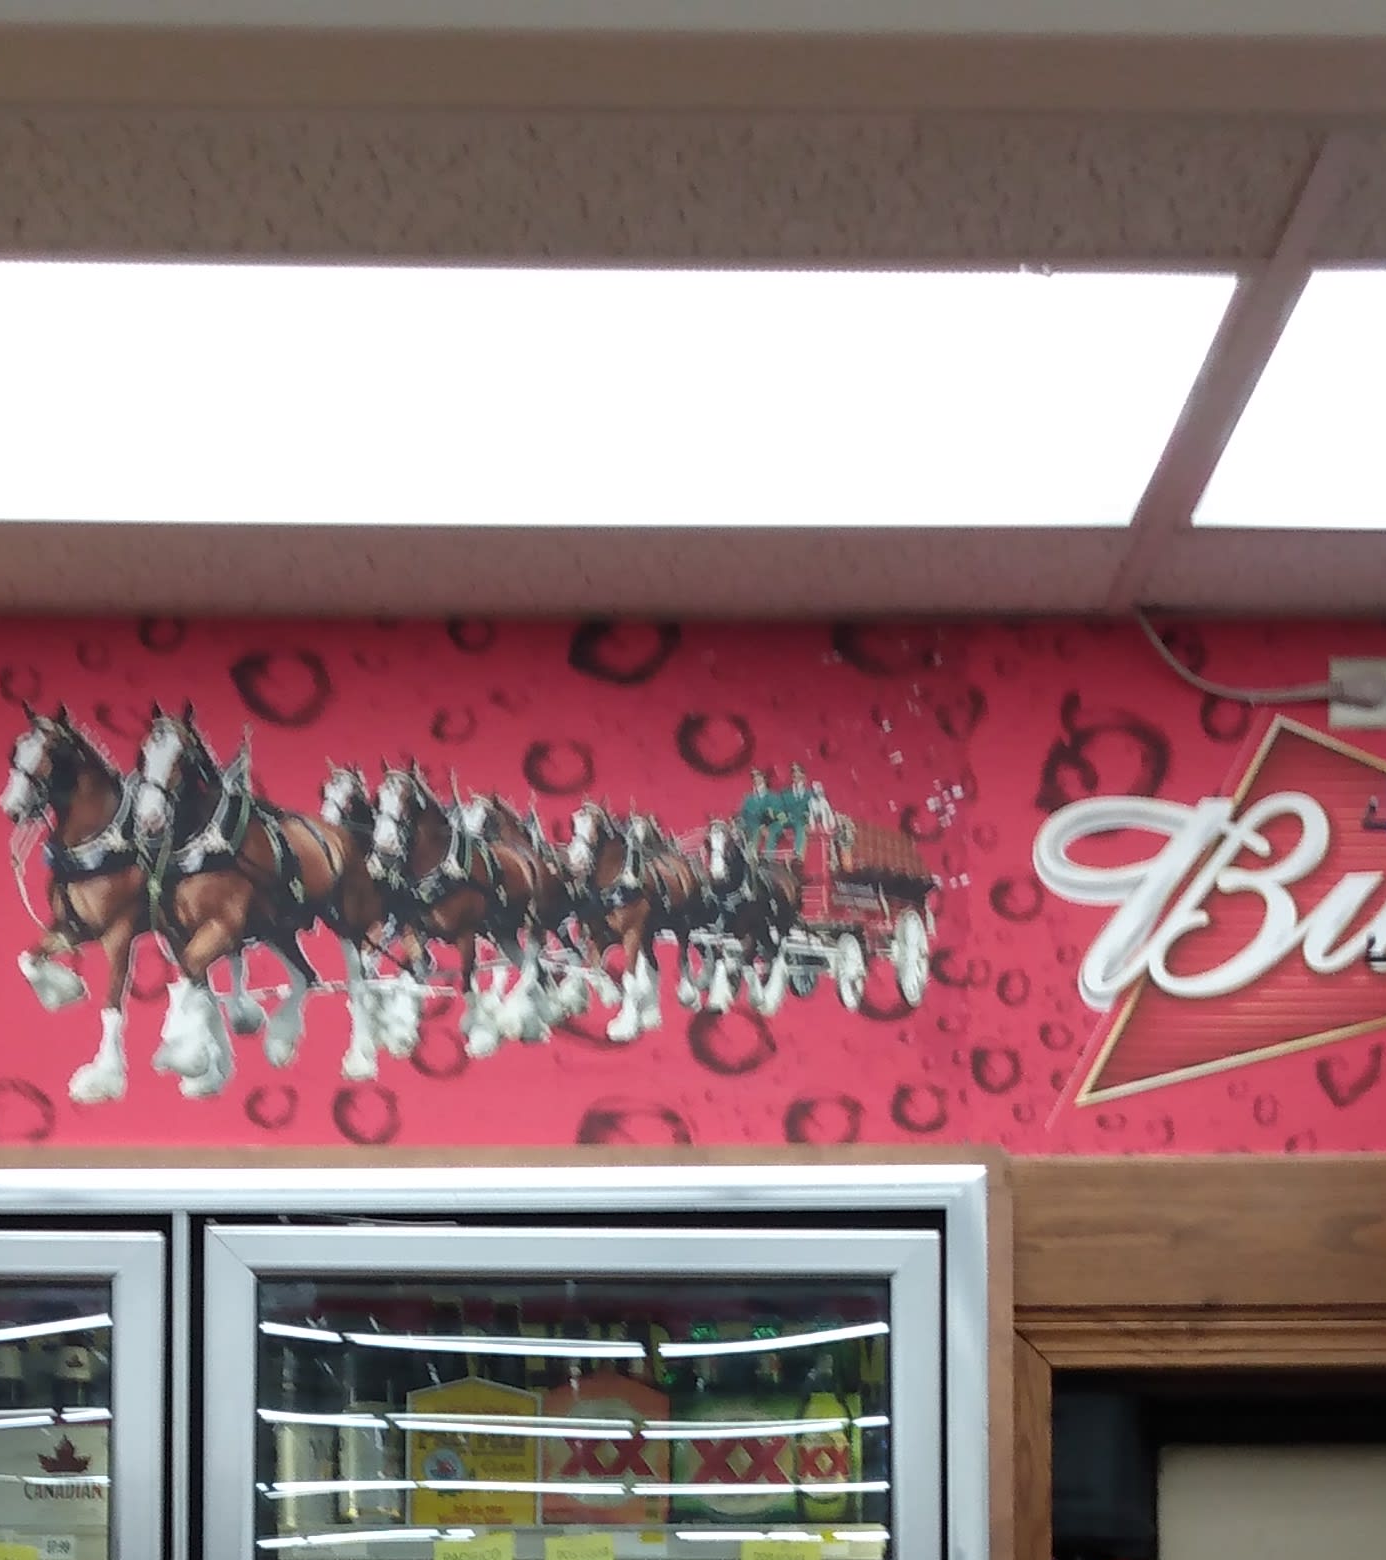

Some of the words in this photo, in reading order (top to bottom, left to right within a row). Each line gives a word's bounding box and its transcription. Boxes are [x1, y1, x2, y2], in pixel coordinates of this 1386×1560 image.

[689, 1434, 795, 1484] XX
[798, 1446, 849, 1478] XX
[23, 1482, 102, 1501] CANADIAN
